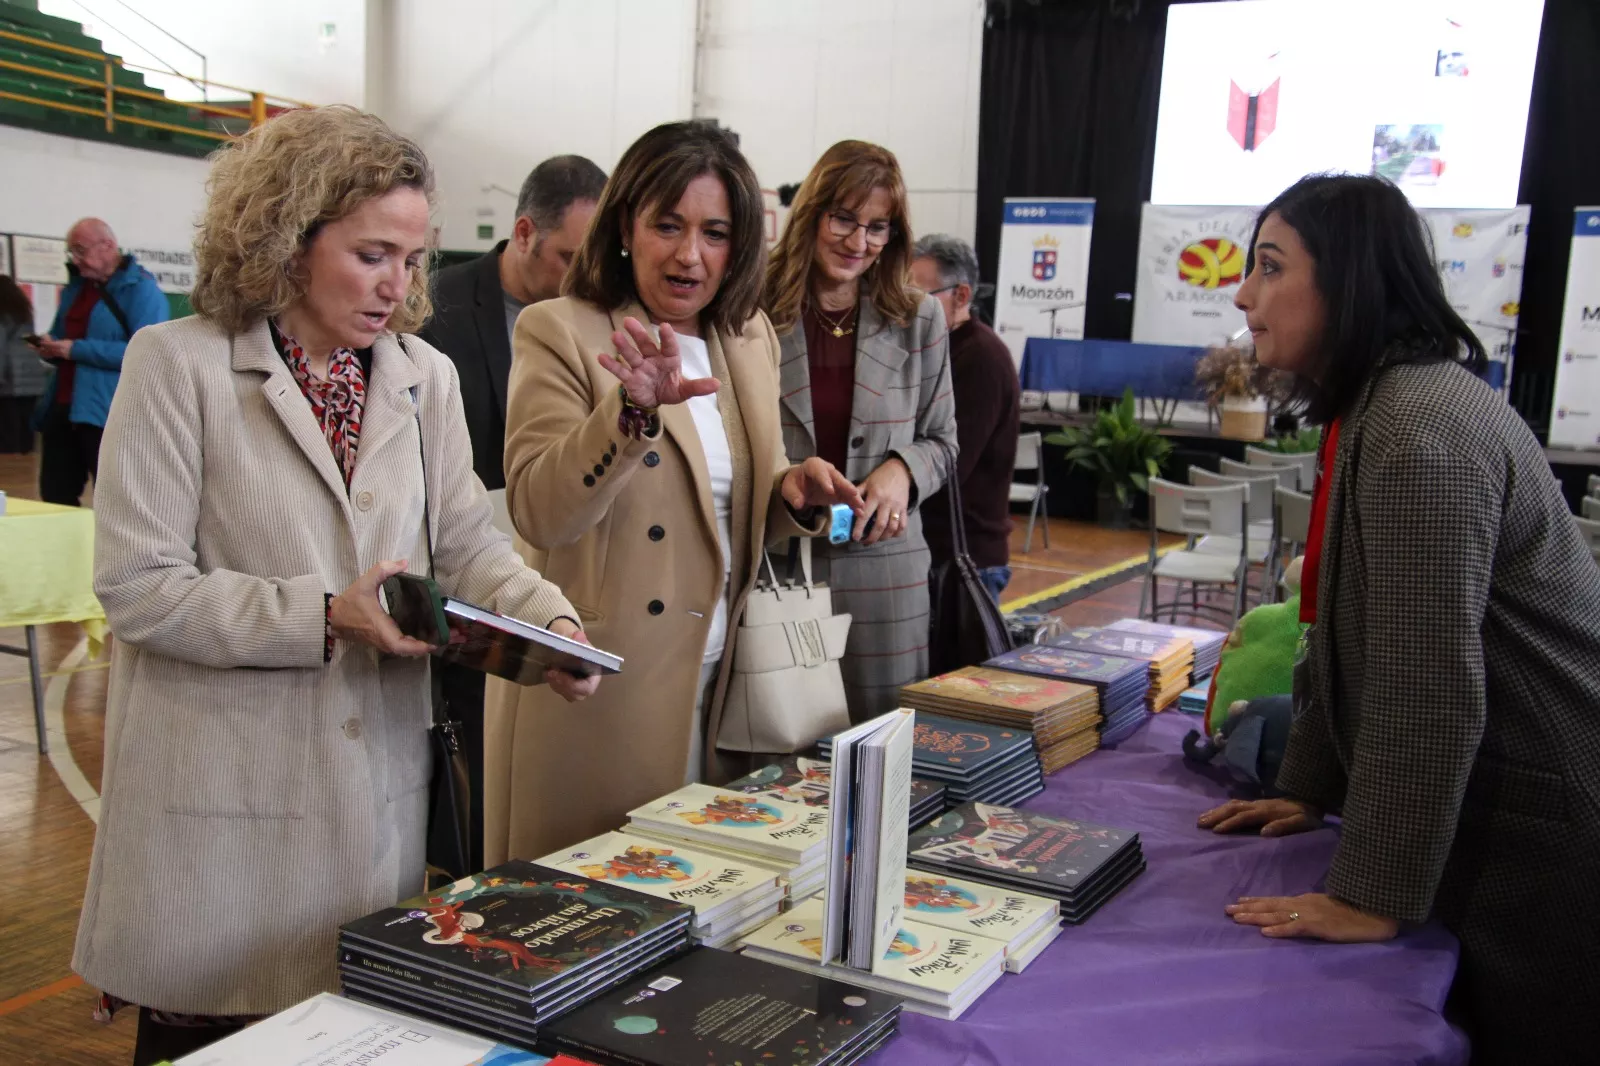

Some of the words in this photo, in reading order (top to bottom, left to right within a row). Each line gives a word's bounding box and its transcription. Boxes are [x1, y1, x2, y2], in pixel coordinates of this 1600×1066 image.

[1010, 286, 1075, 300] Monzón
[558, 903, 588, 916] sin
[584, 907, 622, 920] Un
[510, 914, 571, 938] libros
[524, 918, 590, 949] mundo
[373, 962, 394, 973] mundo
